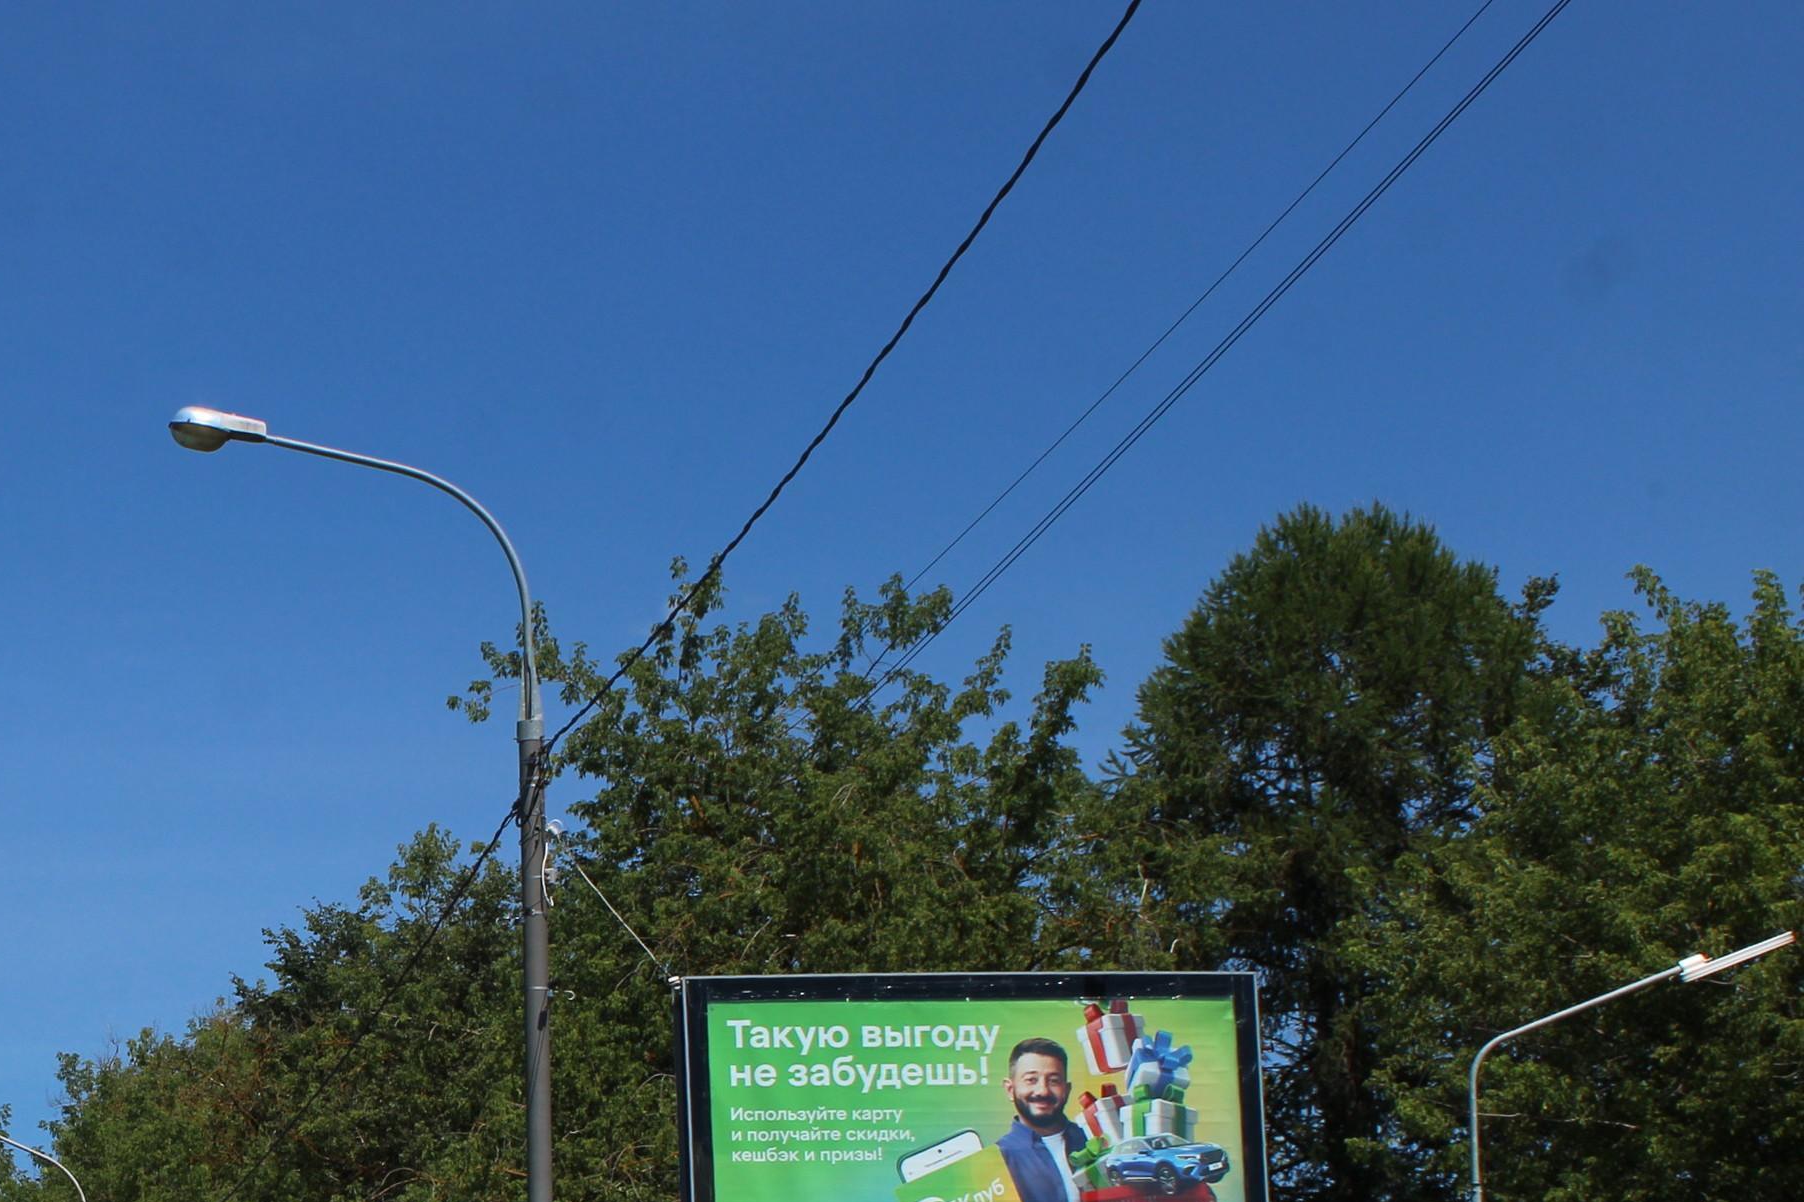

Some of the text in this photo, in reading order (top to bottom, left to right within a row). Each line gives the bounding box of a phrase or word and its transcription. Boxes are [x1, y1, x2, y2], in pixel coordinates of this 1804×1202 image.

[727, 1019, 1000, 1055] Такую выгоду
[730, 1055, 988, 1094] не забудешь!
[730, 1106, 903, 1124] Используйте карту
[731, 1126, 916, 1144] и получайте скидки,
[731, 1146, 883, 1165] кешбэк и призы!
